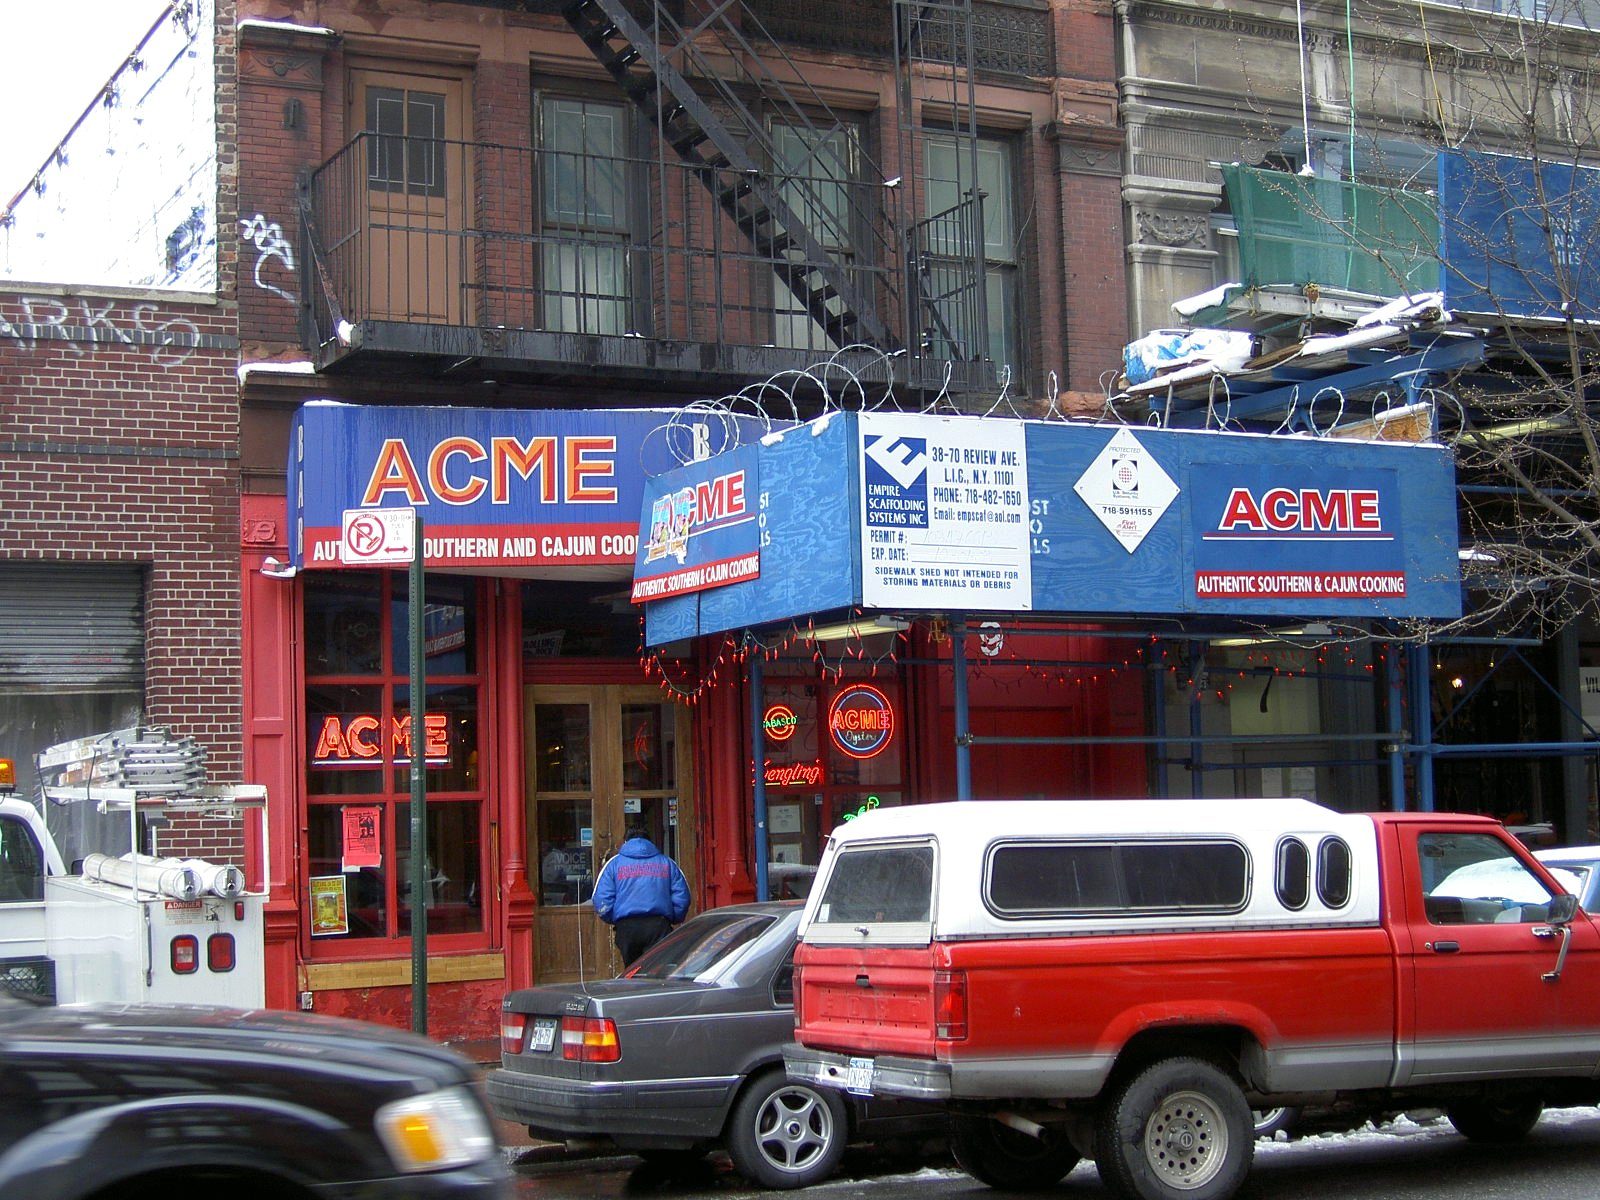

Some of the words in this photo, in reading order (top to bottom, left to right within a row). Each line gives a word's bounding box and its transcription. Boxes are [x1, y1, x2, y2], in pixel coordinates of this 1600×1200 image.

[932, 447, 960, 463] 38-70
[964, 449, 997, 466] REVIEW
[1001, 451, 1021, 467] AVE.
[361, 436, 618, 507] ACME
[973, 470, 990, 485] N.Y.
[994, 471, 1014, 486] 11101
[868, 484, 901, 497] EMPIRE
[933, 487, 962, 504] PHONE:
[965, 489, 1022, 506] 718-482-1650
[868, 498, 926, 512] SCAFFOLDING
[1218, 487, 1382, 531] ACME
[869, 511, 907, 525] SYSTEMS
[909, 513, 927, 525] INC.
[934, 507, 956, 521] Email:
[957, 509, 1021, 524] empscaf@aol.com
[870, 529, 897, 544] PERMIT
[502, 538, 538, 558] AND
[541, 535, 596, 557] CAJUN
[871, 546, 888, 561] EXP.
[889, 547, 909, 562] DATE:
[632, 578, 666, 599] AUTHENTIC
[667, 569, 700, 592] SOUTHERN
[699, 568, 705, 585] &
[706, 563, 729, 583] CAJUN
[729, 555, 759, 578] COOKING
[875, 566, 916, 576] SIDEWALK
[920, 567, 941, 577] SHED
[944, 568, 960, 577] NOT
[963, 569, 1001, 579] INTENDED
[1004, 570, 1019, 579] FOR
[883, 577, 919, 587] STORING
[921, 578, 967, 588] MATERIALS
[970, 579, 981, 588] OR
[983, 580, 1012, 590] DEBRIS
[1197, 575, 1256, 593] AUTHENTIC
[1258, 575, 1313, 593] SOUTHERN
[1314, 576, 1322, 592] &
[1324, 576, 1358, 593] CAJUN
[1359, 576, 1405, 593] COOKING
[1253, 666, 1274, 714] 7
[831, 709, 891, 730] ACME
[314, 714, 448, 758] ACME
[173, 901, 201, 909] DANGER
